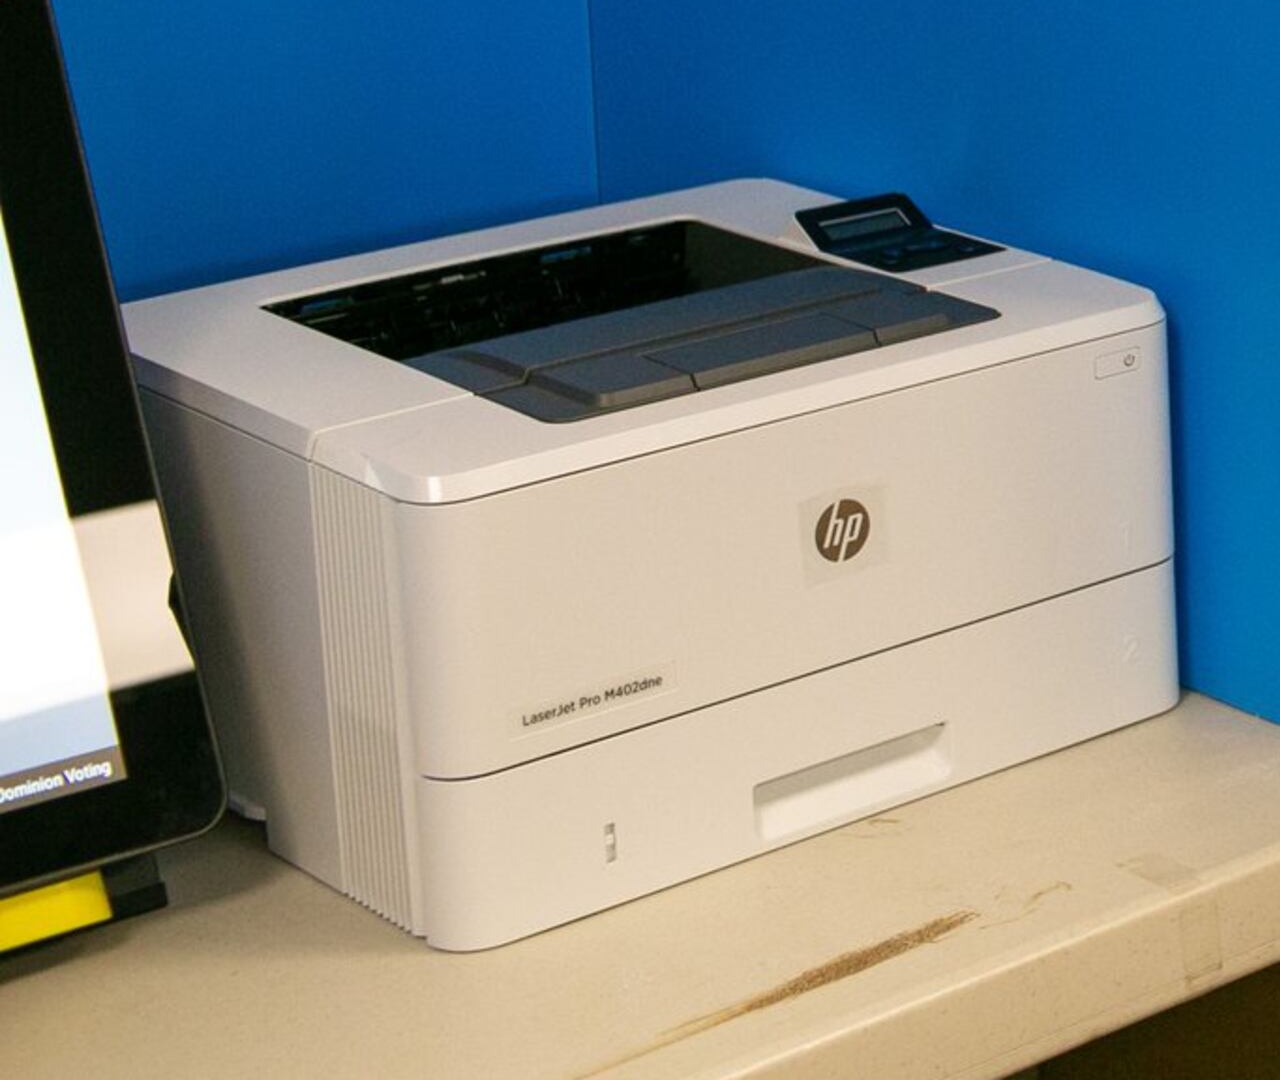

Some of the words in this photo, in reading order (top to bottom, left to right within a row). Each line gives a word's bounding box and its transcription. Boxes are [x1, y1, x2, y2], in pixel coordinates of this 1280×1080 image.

[820, 499, 866, 563] hp
[522, 700, 576, 727] LaserJet
[579, 694, 601, 710] Pro
[604, 676, 663, 701] M402dne
[63, 761, 113, 785] Voting
